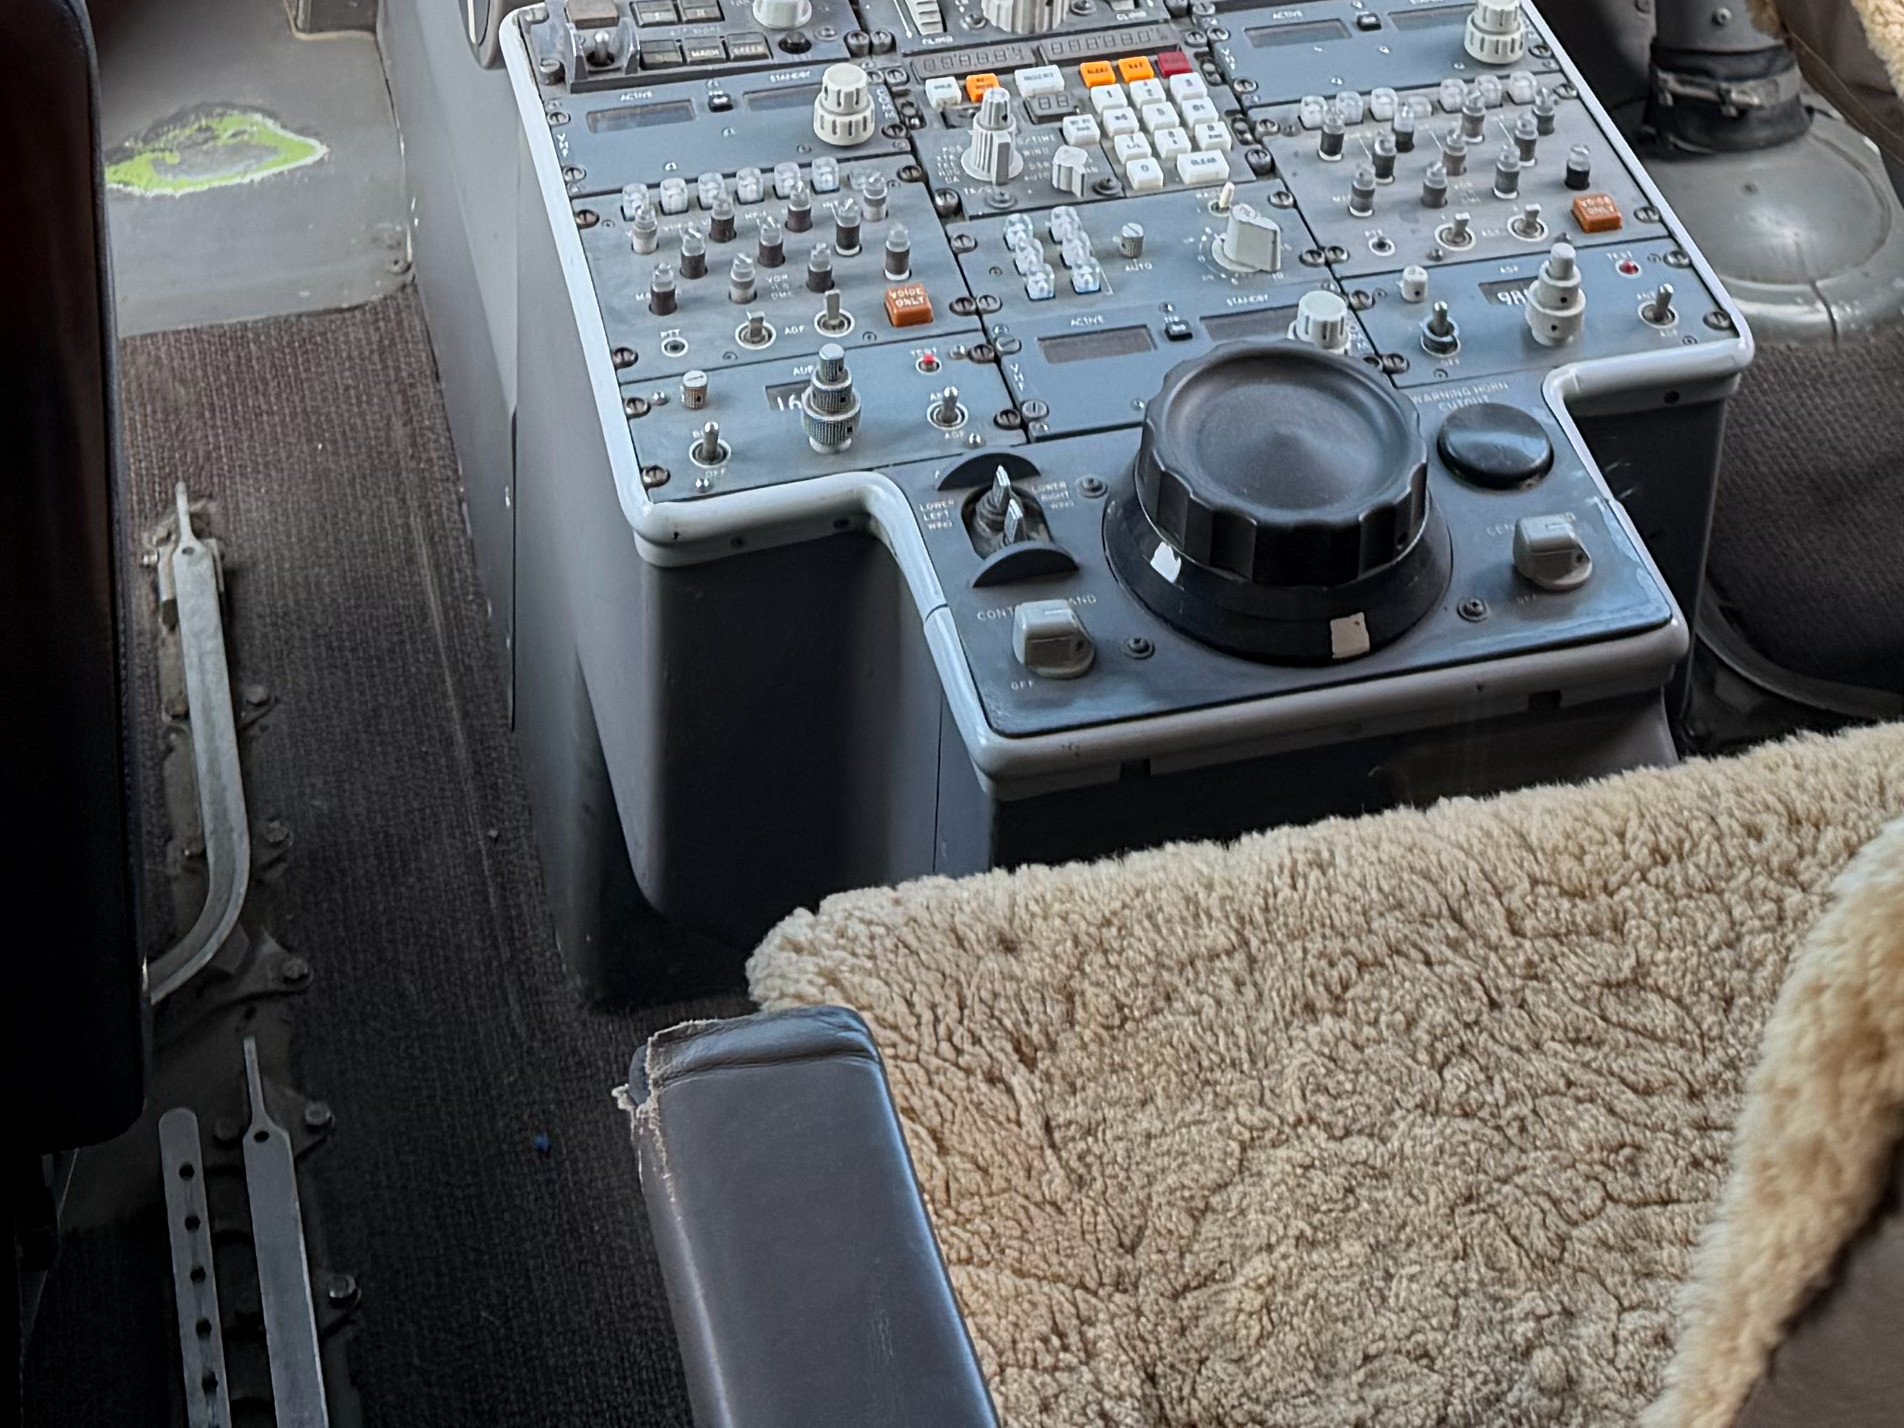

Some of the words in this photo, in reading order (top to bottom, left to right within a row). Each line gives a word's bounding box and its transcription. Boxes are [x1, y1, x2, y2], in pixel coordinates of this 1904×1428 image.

[895, 296, 925, 307] ONLY
[1411, 390, 1469, 406] WARNING
[1474, 382, 1509, 394] HORN
[919, 500, 954, 512] LOWER
[923, 510, 949, 521] LEFT
